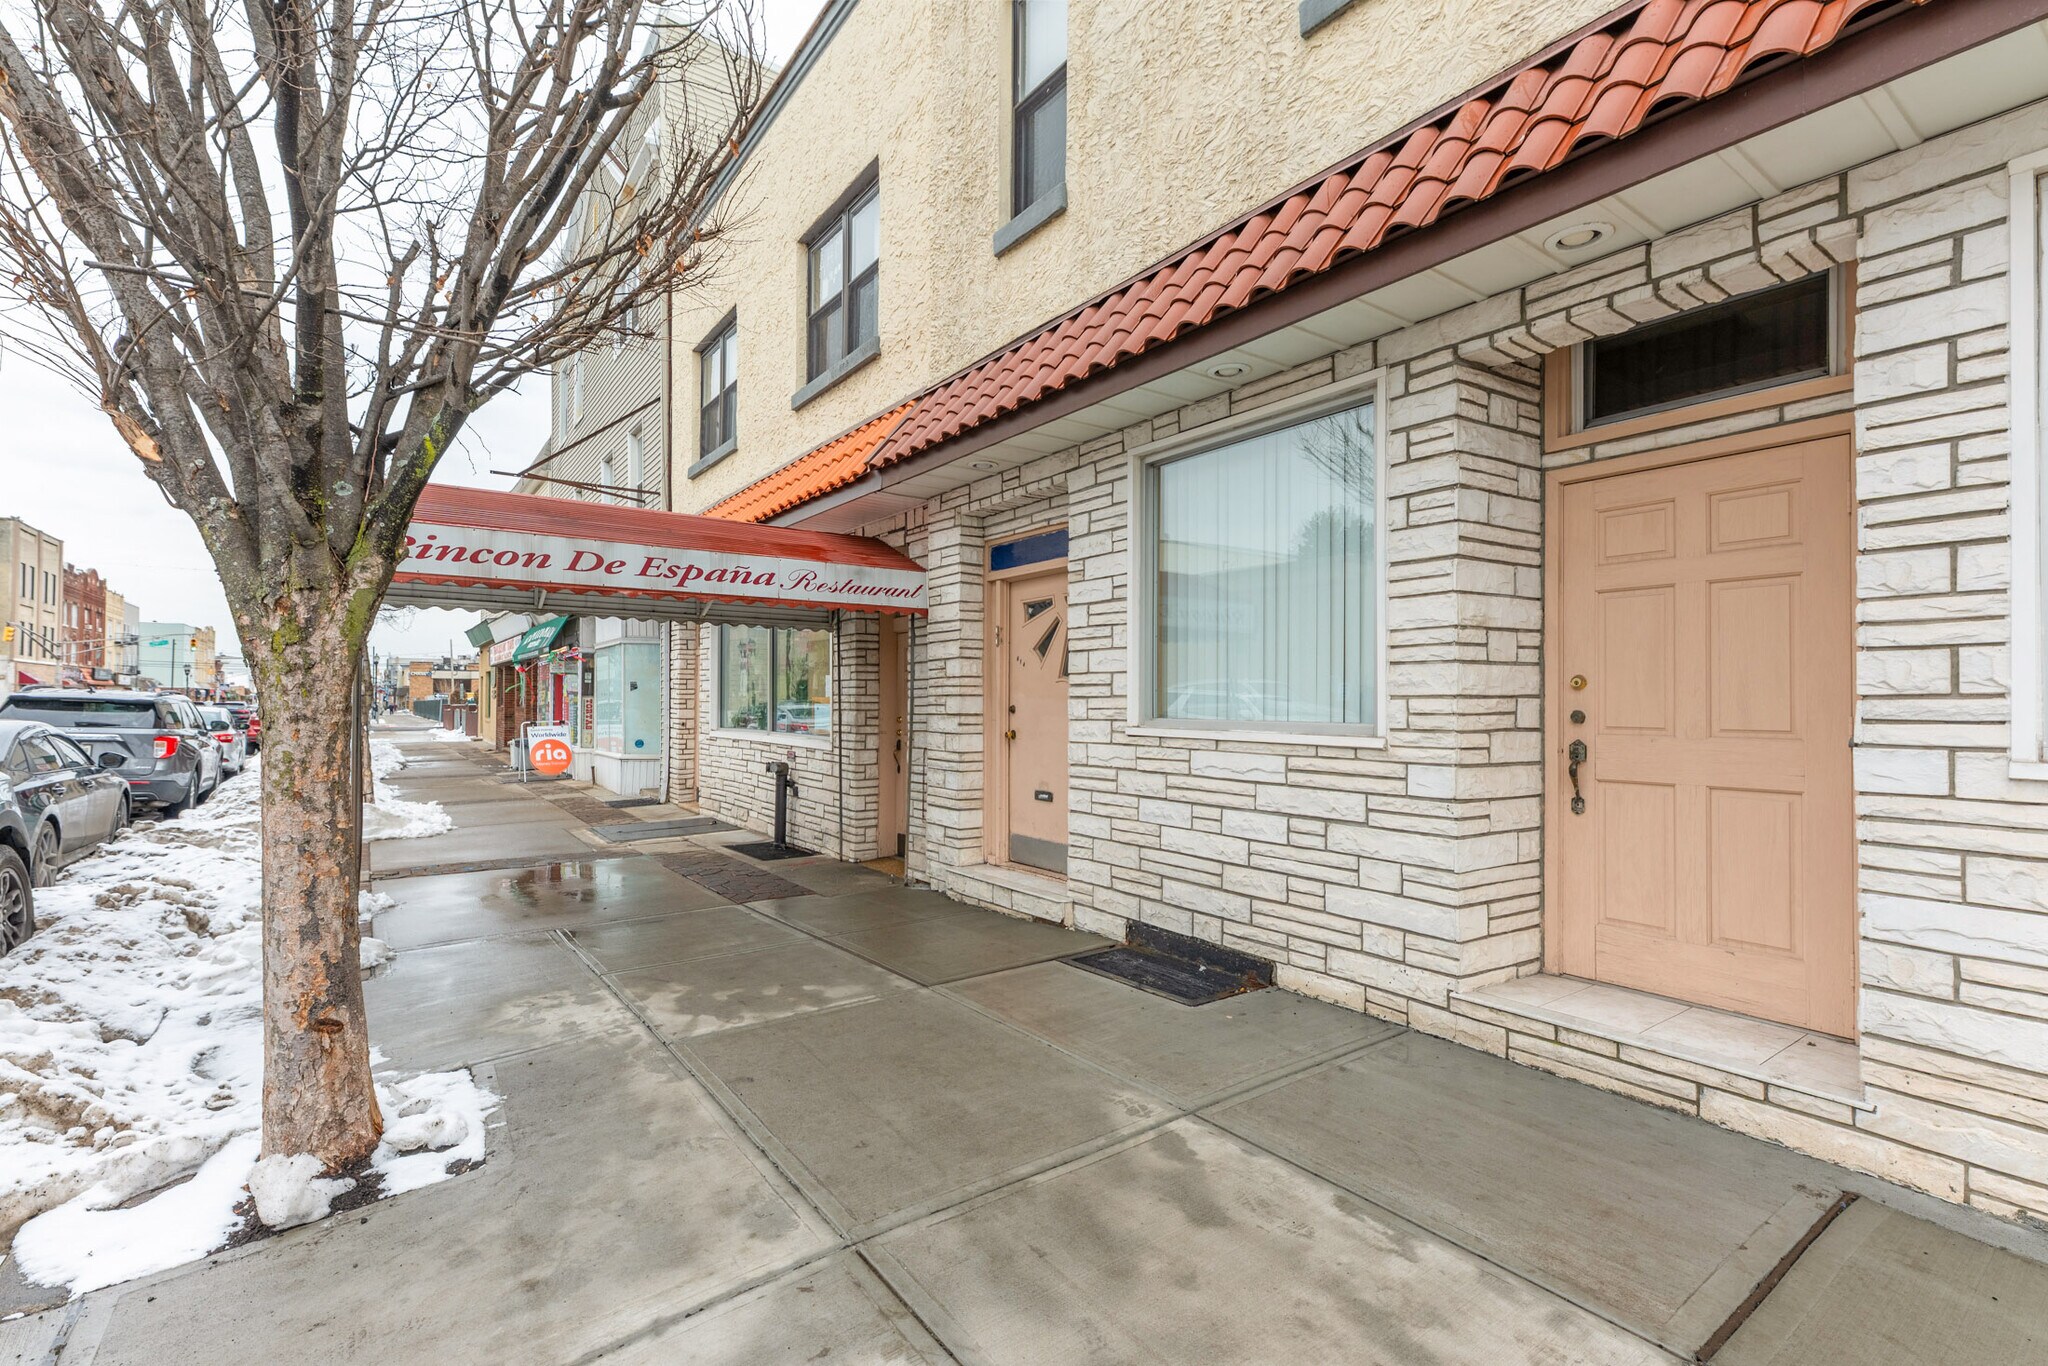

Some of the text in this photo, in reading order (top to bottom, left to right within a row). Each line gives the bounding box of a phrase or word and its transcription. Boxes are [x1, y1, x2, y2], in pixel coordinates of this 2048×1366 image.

[563, 550, 627, 575] De
[634, 556, 777, 588] España
[779, 568, 925, 599] Restaurant
[535, 743, 567, 761] ria
